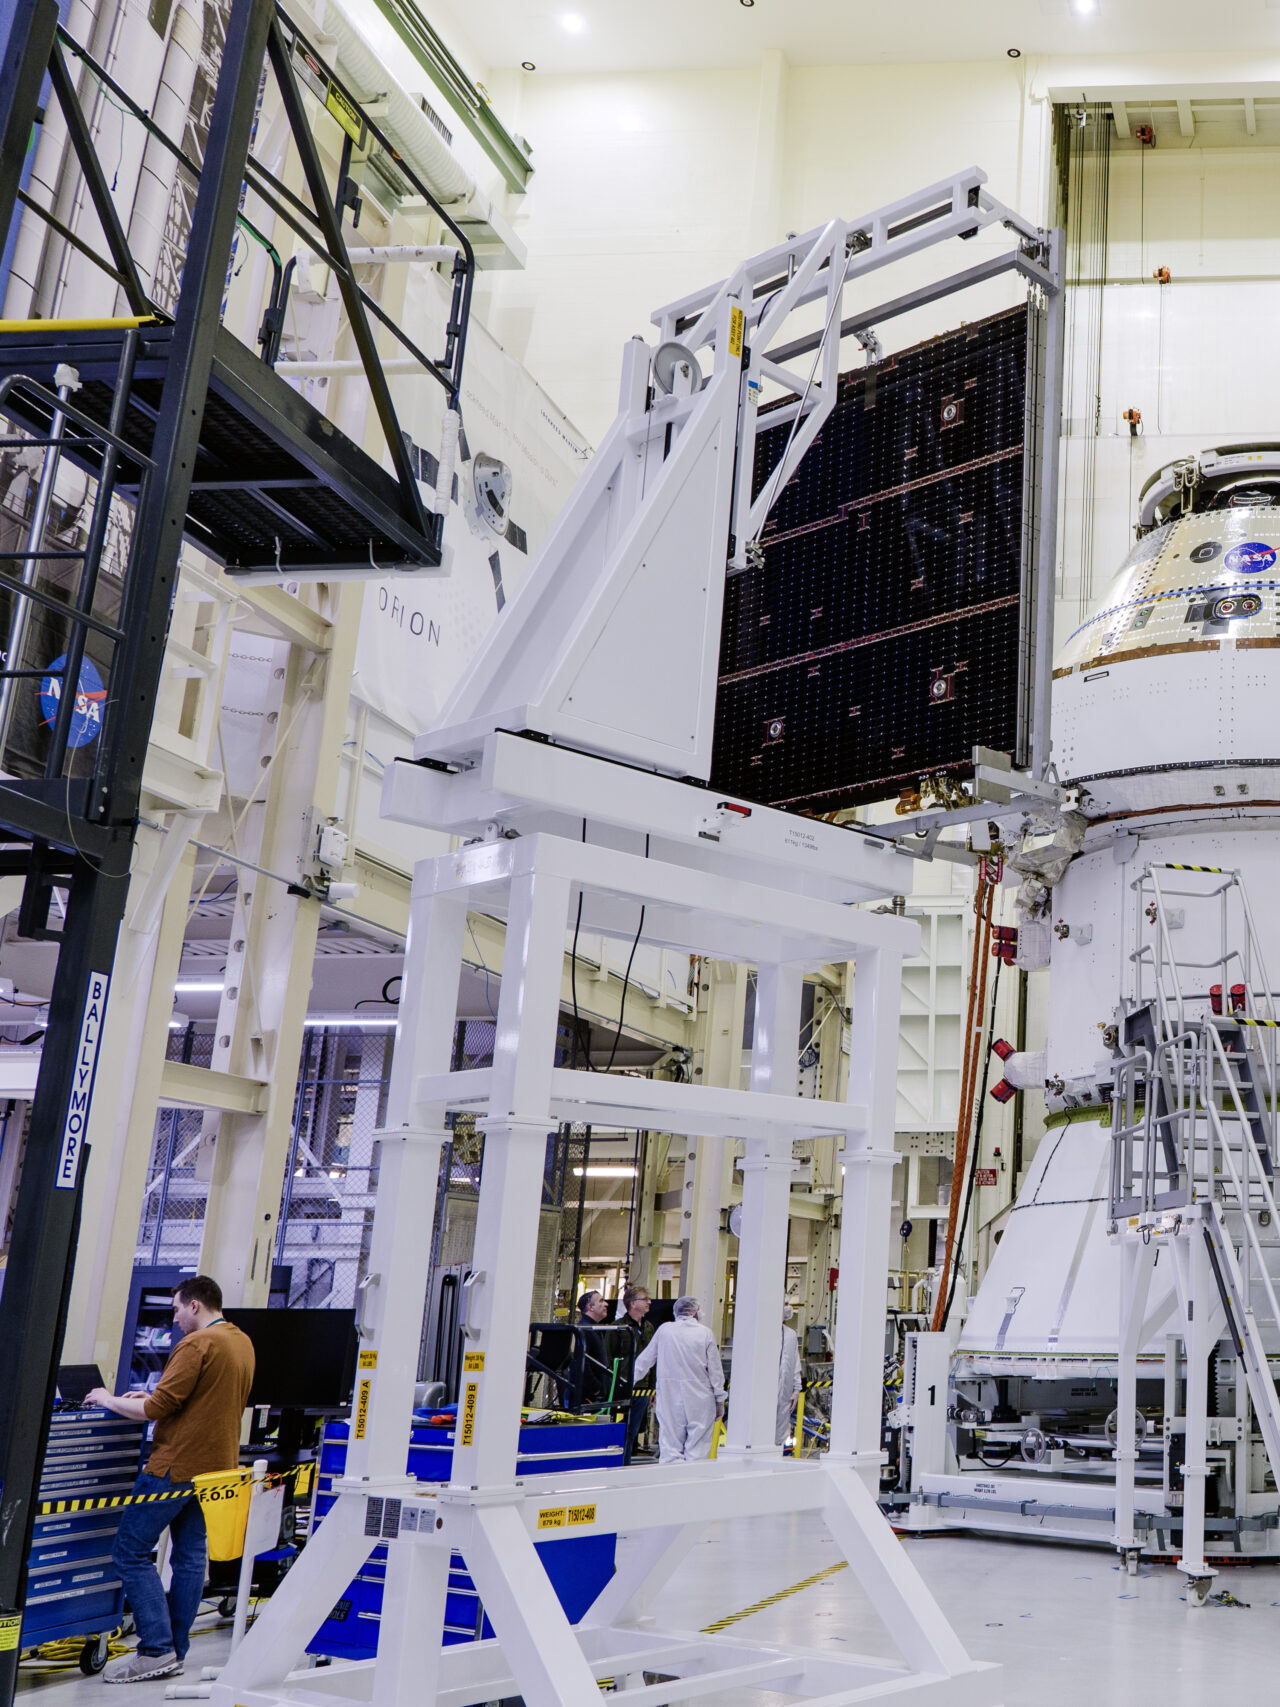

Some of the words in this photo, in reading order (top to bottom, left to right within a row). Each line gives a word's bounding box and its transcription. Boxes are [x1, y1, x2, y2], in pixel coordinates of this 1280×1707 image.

[379, 586, 441, 648] ORION
[47, 676, 101, 723] NSA
[62, 981, 103, 1179] BALLYMORE
[357, 1390, 369, 1439] T15012-409
[463, 1395, 475, 1445] T15012-409
[928, 1385, 936, 1406] 1
[200, 1489, 239, 1503] F.O.D.
